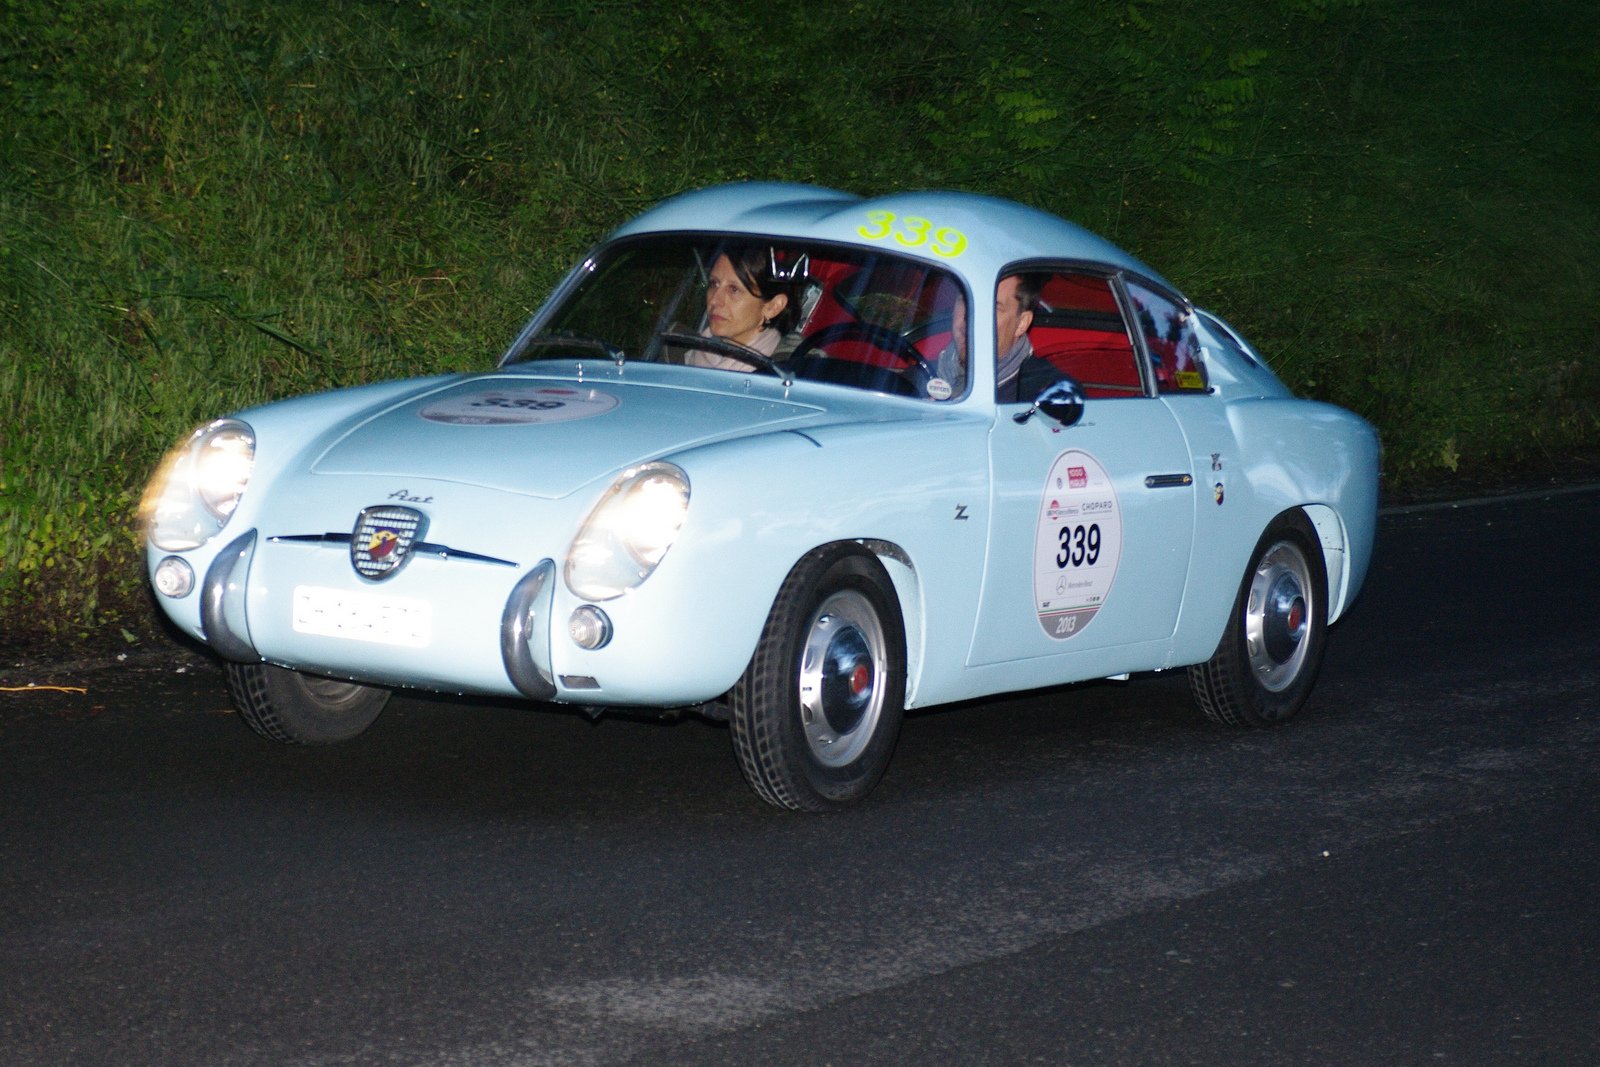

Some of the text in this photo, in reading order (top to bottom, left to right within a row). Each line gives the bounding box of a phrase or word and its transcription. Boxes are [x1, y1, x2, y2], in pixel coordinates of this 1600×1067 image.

[859, 210, 967, 257] 339
[472, 398, 565, 410] 339
[954, 503, 969, 520] Z
[1082, 501, 1112, 511] CHOPARD
[1057, 524, 1101, 569] 339
[1056, 616, 1076, 634] 2013
